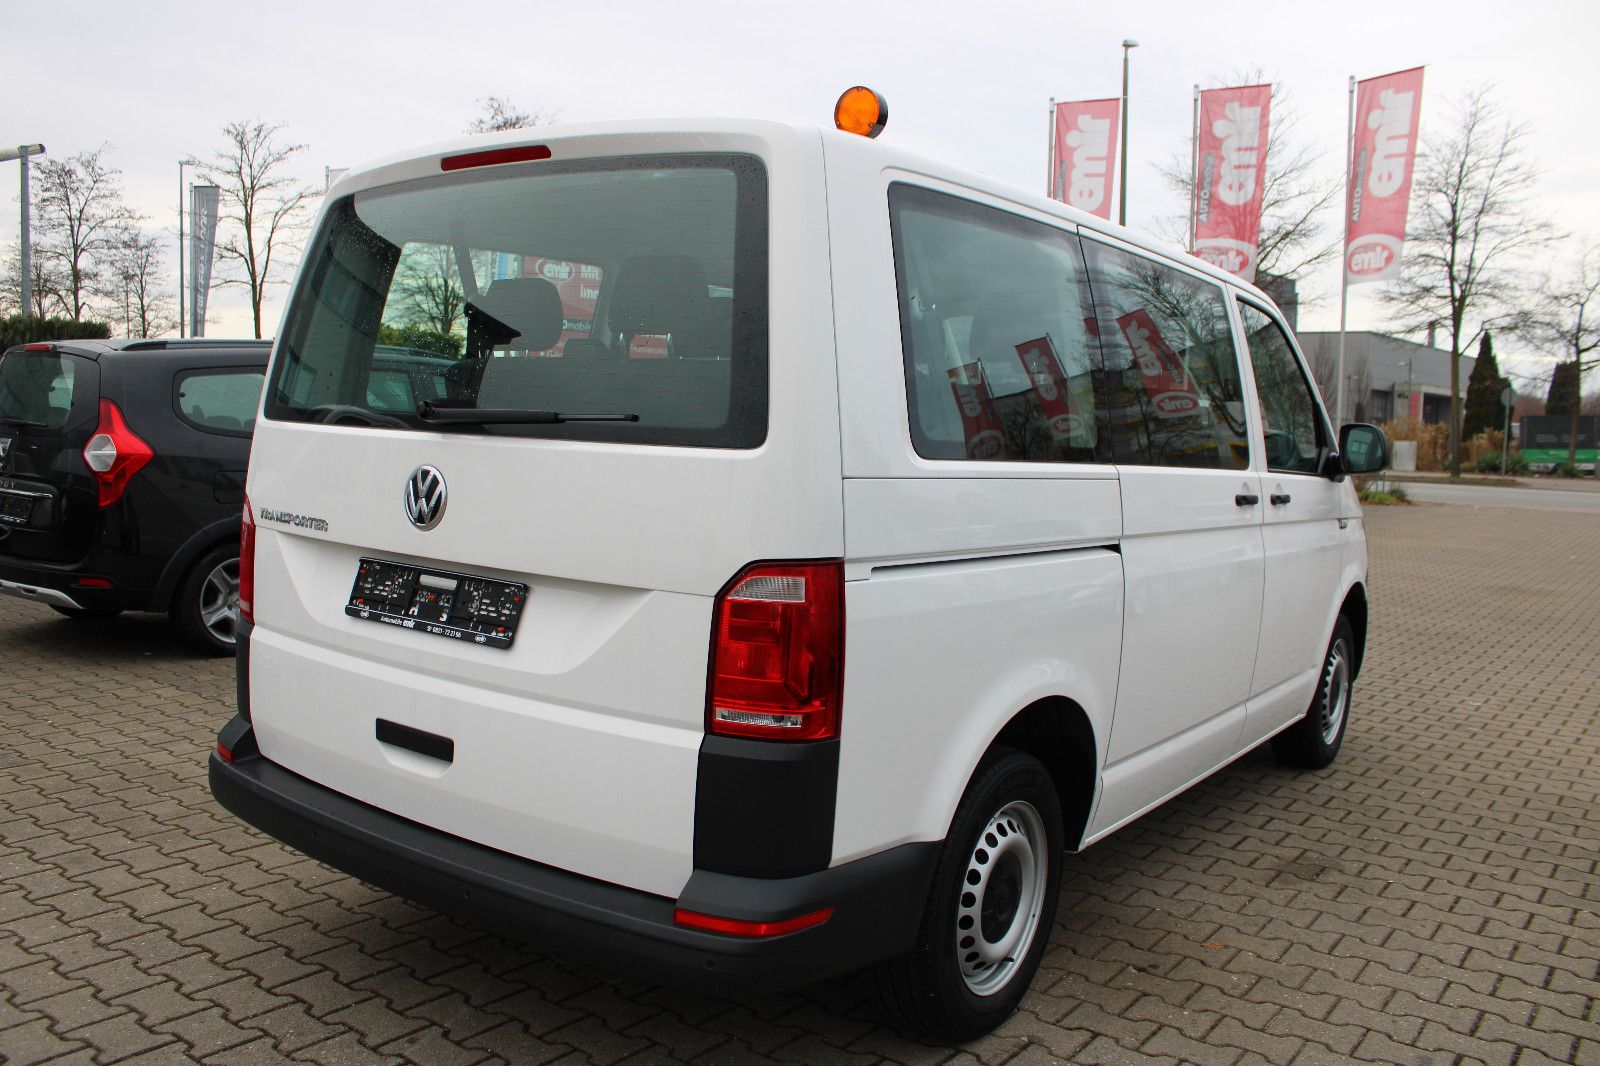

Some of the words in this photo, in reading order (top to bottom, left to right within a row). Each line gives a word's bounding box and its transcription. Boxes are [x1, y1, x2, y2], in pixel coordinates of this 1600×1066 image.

[1066, 113, 1111, 212] emir
[1212, 102, 1261, 206] emir
[1368, 89, 1415, 198] emir
[1351, 246, 1389, 272] emir
[260, 507, 329, 532] TRANSPORTER
